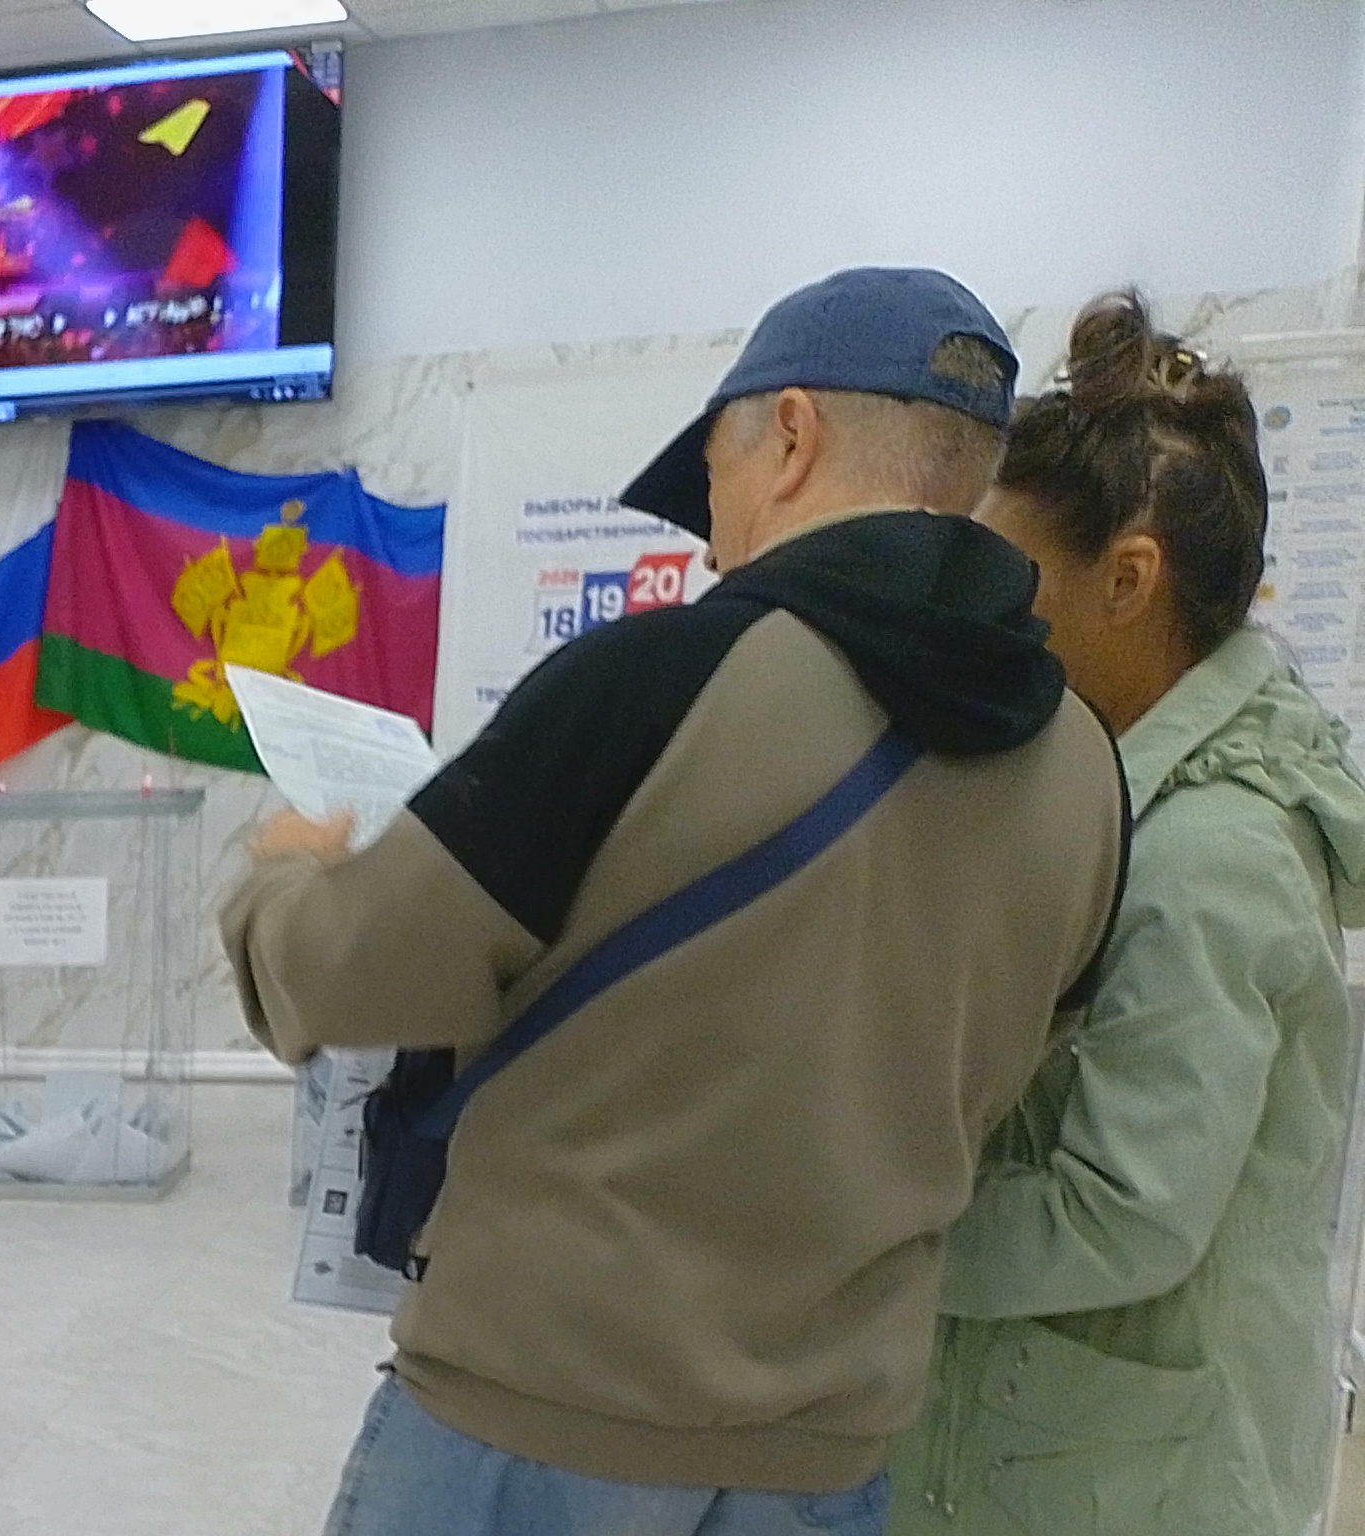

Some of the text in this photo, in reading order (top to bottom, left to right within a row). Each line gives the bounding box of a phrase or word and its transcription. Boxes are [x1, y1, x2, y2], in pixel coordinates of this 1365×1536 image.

[543, 564, 681, 639] 18 19 20
